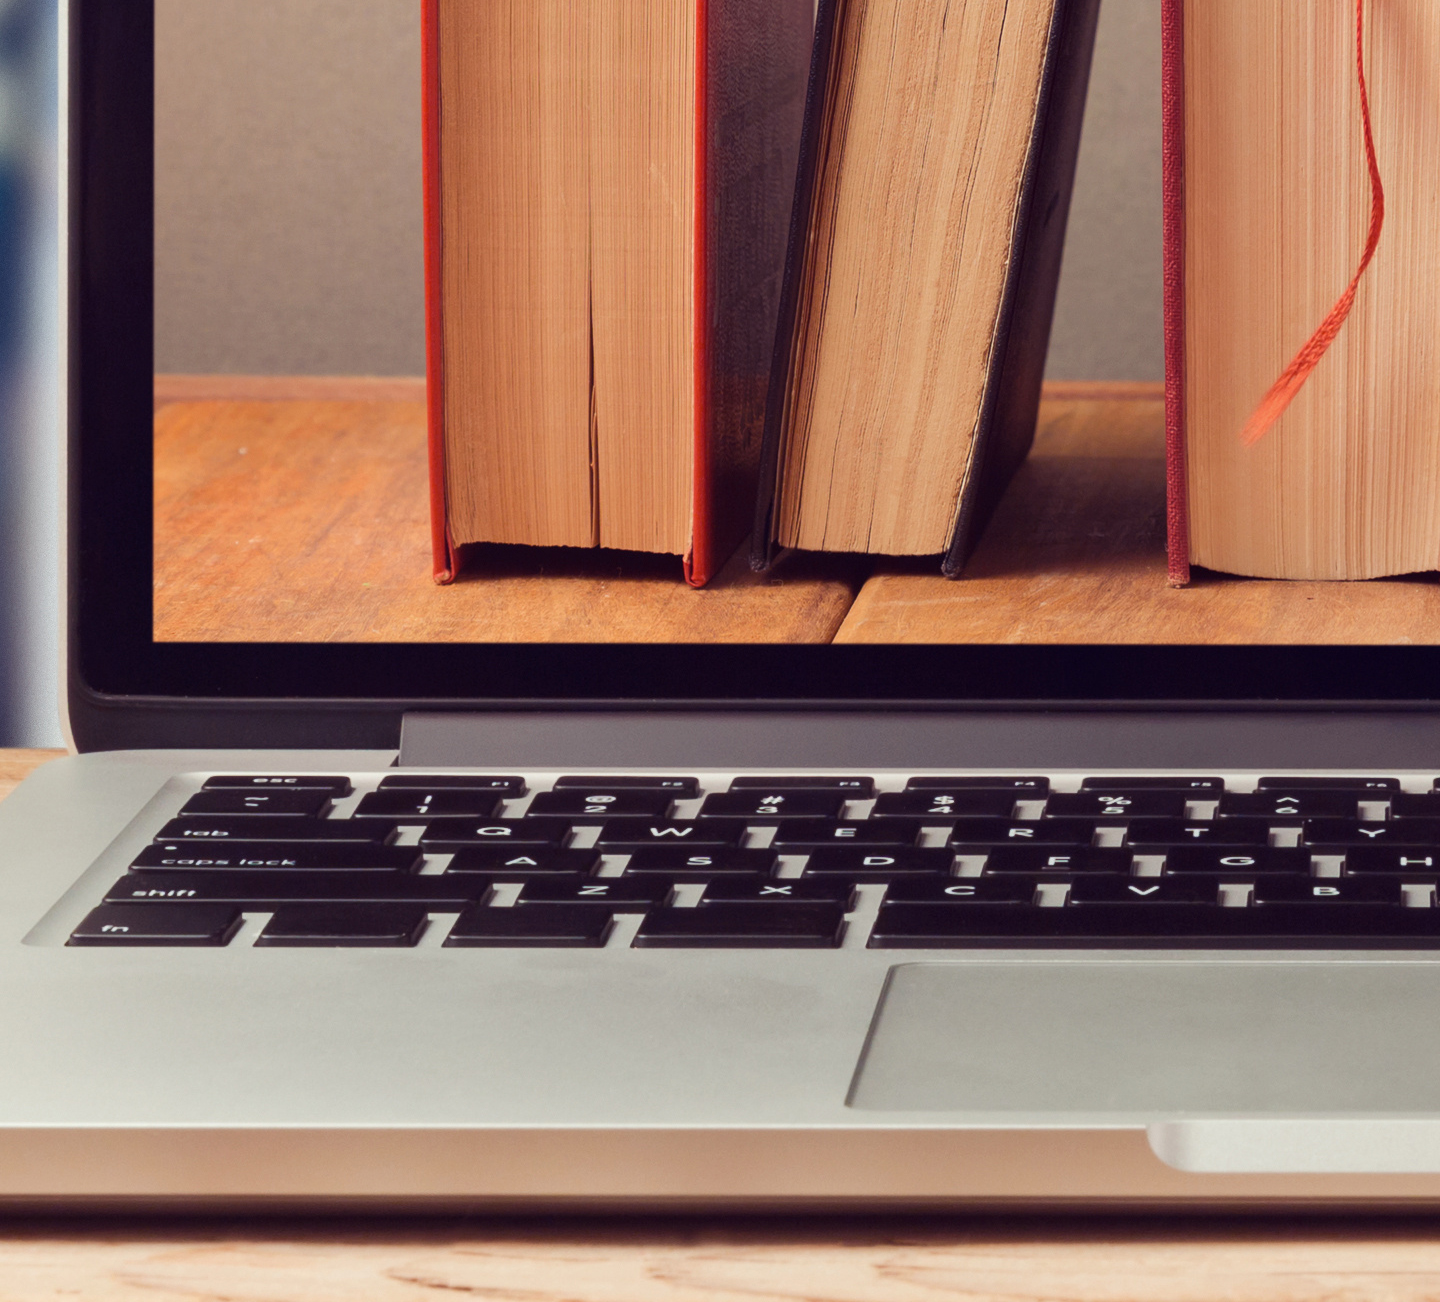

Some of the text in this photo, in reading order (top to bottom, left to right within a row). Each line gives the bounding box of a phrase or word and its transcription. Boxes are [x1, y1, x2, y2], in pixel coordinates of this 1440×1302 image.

[584, 795, 617, 804] @
[760, 795, 785, 805] #
[932, 795, 955, 806] $
[1097, 796, 1132, 806] %
[416, 805, 429, 814] 1
[583, 804, 607, 814] 2
[755, 805, 779, 814] 3
[927, 805, 953, 814] 4
[1101, 806, 1125, 815] 5
[1275, 806, 1299, 815] 6
[183, 829, 229, 837] tab
[476, 825, 513, 837] Q
[649, 827, 694, 837] W
[834, 827, 857, 838] E
[1008, 828, 1034, 838] R
[1184, 827, 1210, 838] T
[1358, 828, 1386, 838] Y
[161, 857, 296, 867] caps lock
[504, 856, 538, 866] A
[686, 856, 713, 866] S
[862, 856, 895, 866] D
[1047, 856, 1071, 866] F
[1219, 856, 1256, 866] G
[1399, 856, 1433, 867] H
[131, 889, 197, 897] shift
[577, 885, 610, 896] Z
[759, 885, 793, 895] X
[944, 885, 976, 896] C
[1127, 885, 1160, 896] V
[1312, 886, 1341, 896] B
[100, 924, 130, 933] fn
